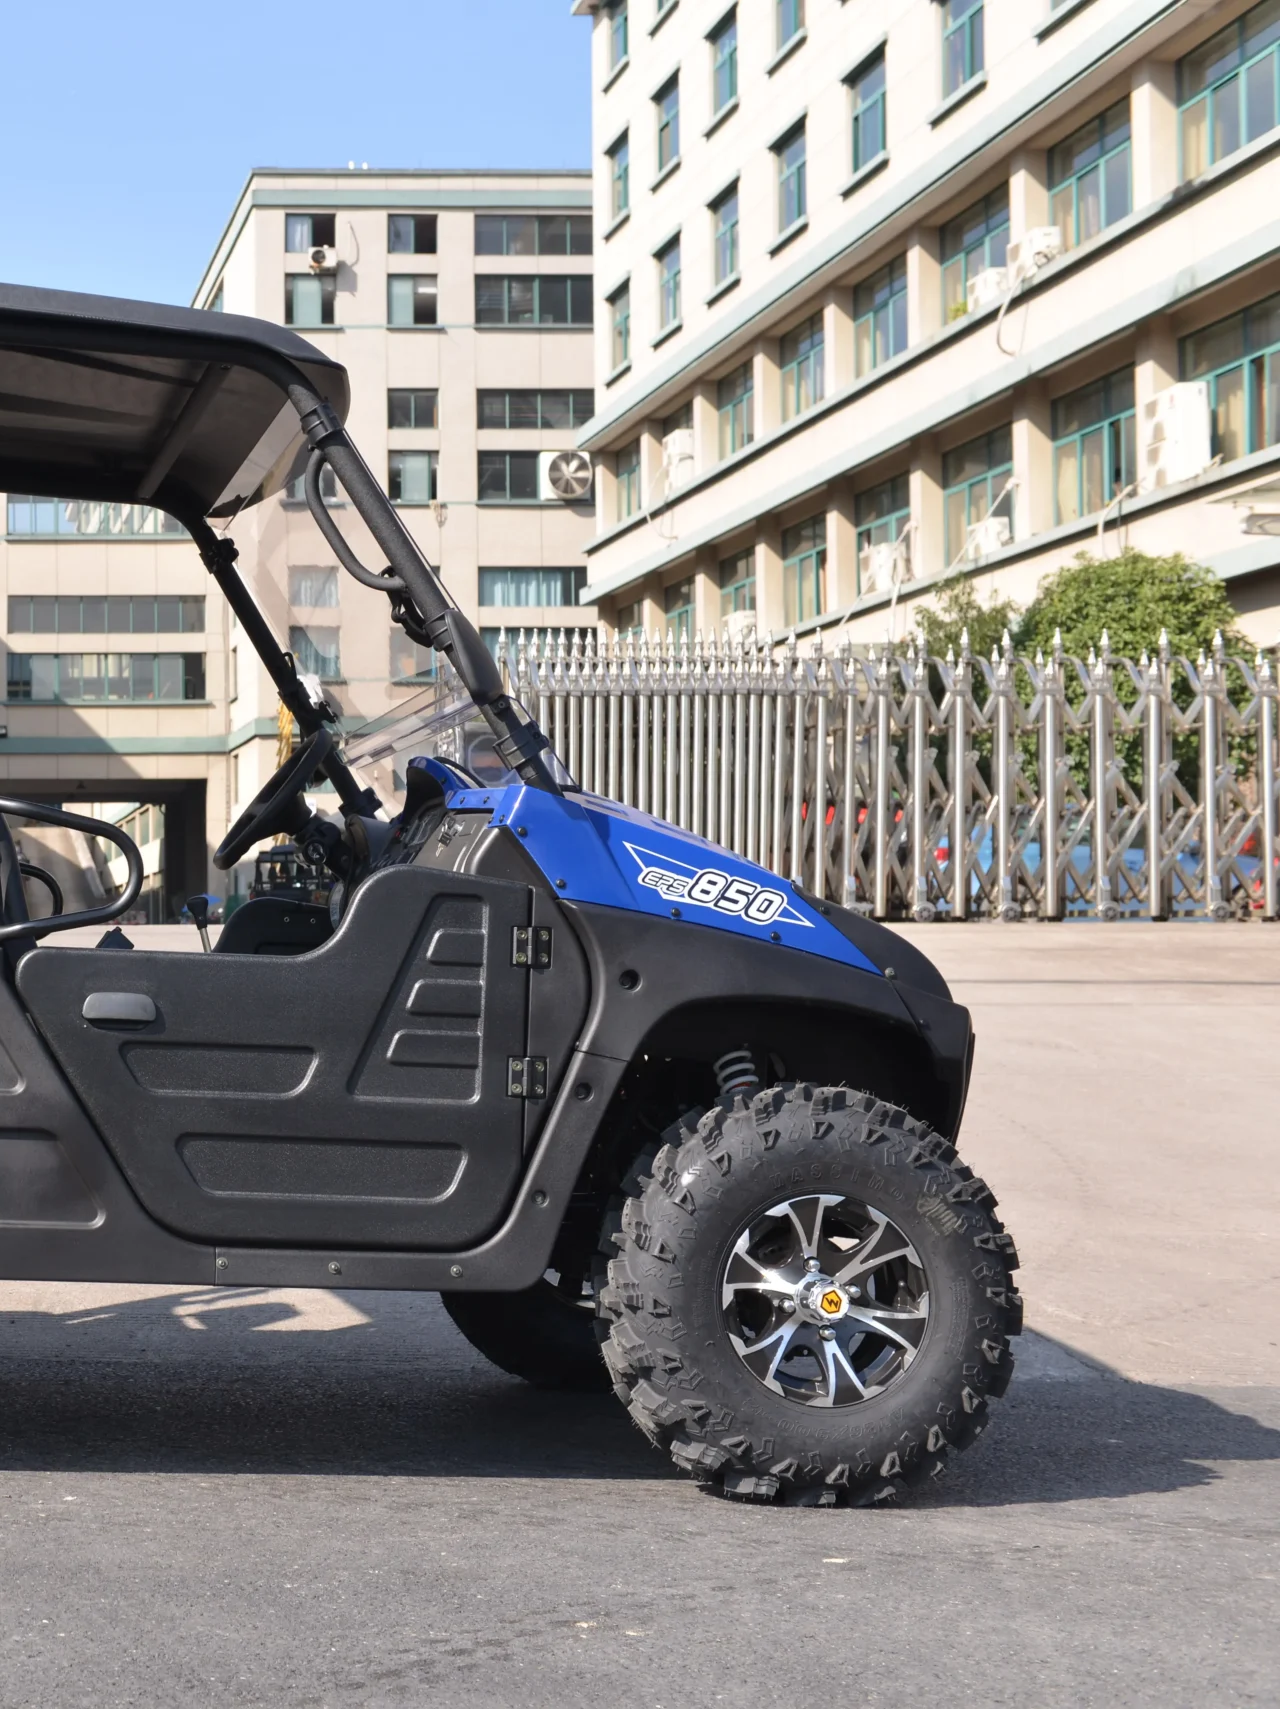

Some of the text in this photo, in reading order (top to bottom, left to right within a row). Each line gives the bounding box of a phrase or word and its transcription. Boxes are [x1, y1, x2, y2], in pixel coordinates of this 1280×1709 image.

[640, 868, 786, 923] EPS 850
[768, 1162, 905, 1201] MASSIMO
